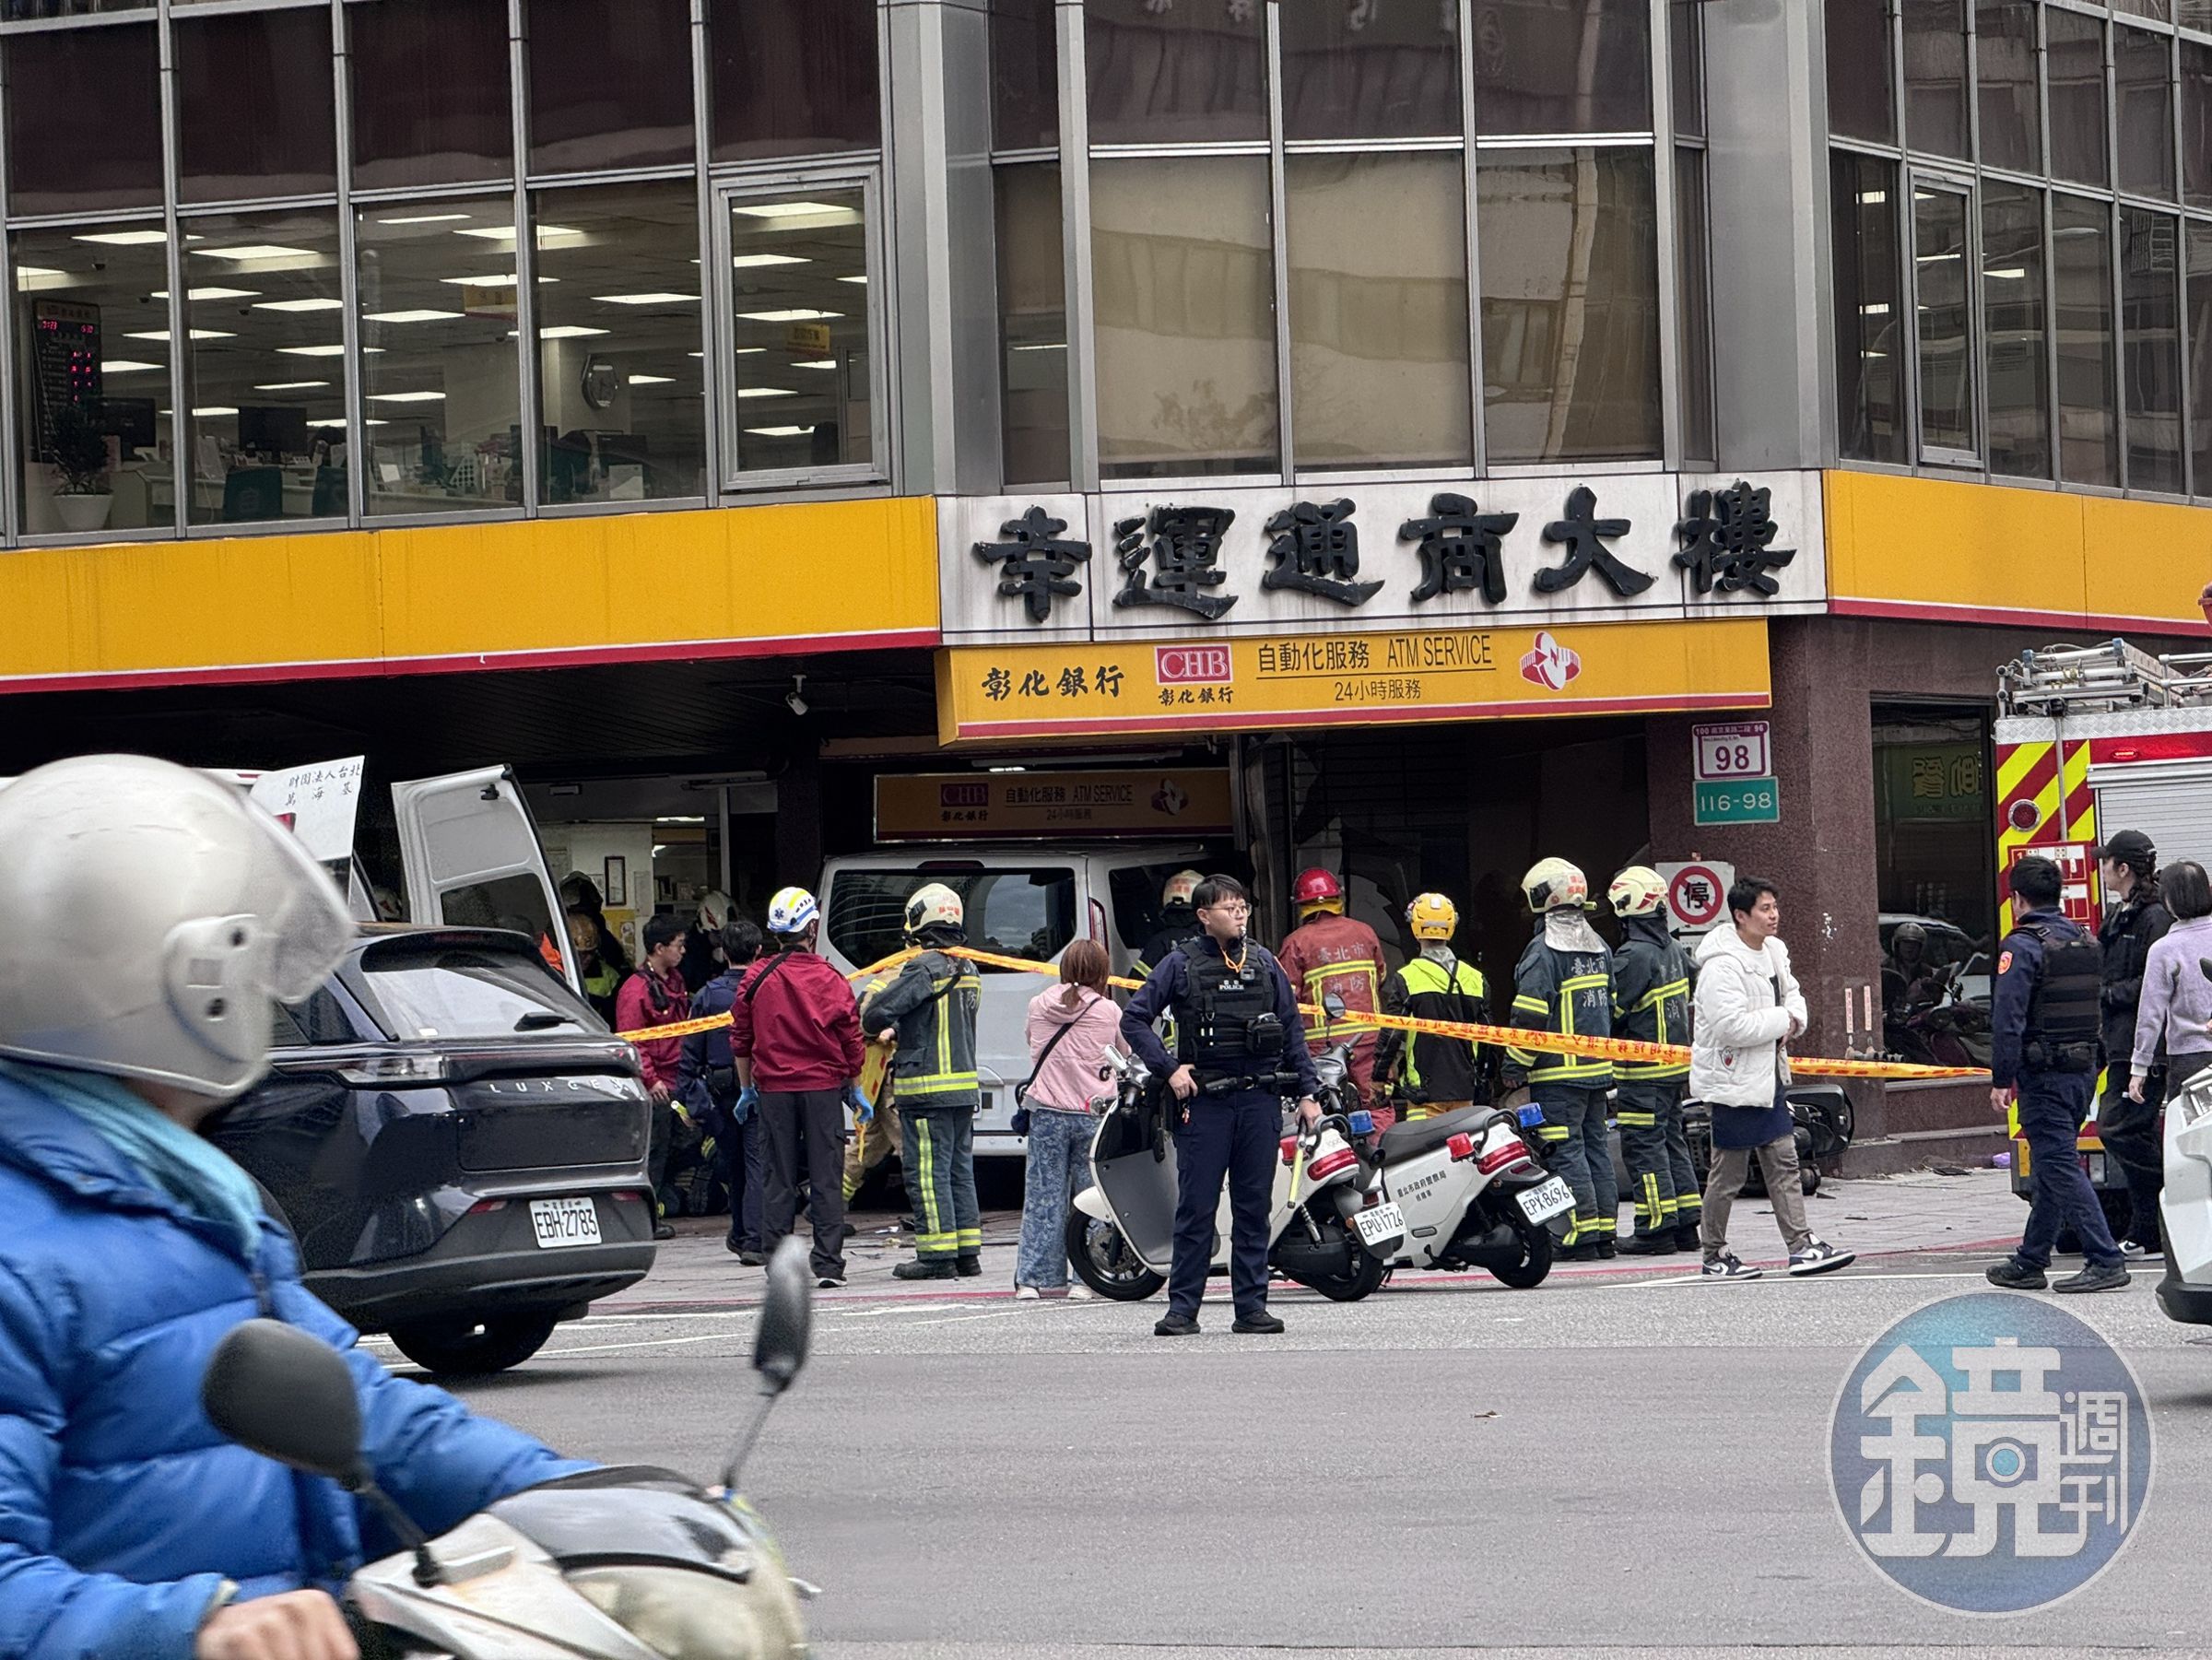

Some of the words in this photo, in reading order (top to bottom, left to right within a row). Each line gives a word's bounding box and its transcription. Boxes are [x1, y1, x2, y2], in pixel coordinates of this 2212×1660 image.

[973, 480, 1797, 623] 幸運通商大樓
[1160, 650, 1228, 678] CHB
[1258, 640, 1370, 672] 自動化服務
[1387, 638, 1419, 667] ATM
[1424, 634, 1492, 665] SERVICE
[982, 665, 1124, 701] 彰化銀行
[1158, 686, 1234, 706] 彰化銀行
[1334, 679, 1421, 701] 24小時服務
[1715, 745, 1749, 771] 98
[942, 785, 987, 804] CHB
[1006, 786, 1066, 804] 自動化服務
[1072, 785, 1092, 803] ATM
[1094, 784, 1133, 802] SERVICE
[1700, 793, 1771, 811] 116-98
[1684, 882, 1709, 909] 停
[1583, 988, 1607, 1008] 消防
[1523, 1186, 1571, 1218] EPX-8696
[535, 1208, 597, 1239] EBH-2783
[1359, 1207, 1405, 1238] EPU-1726
